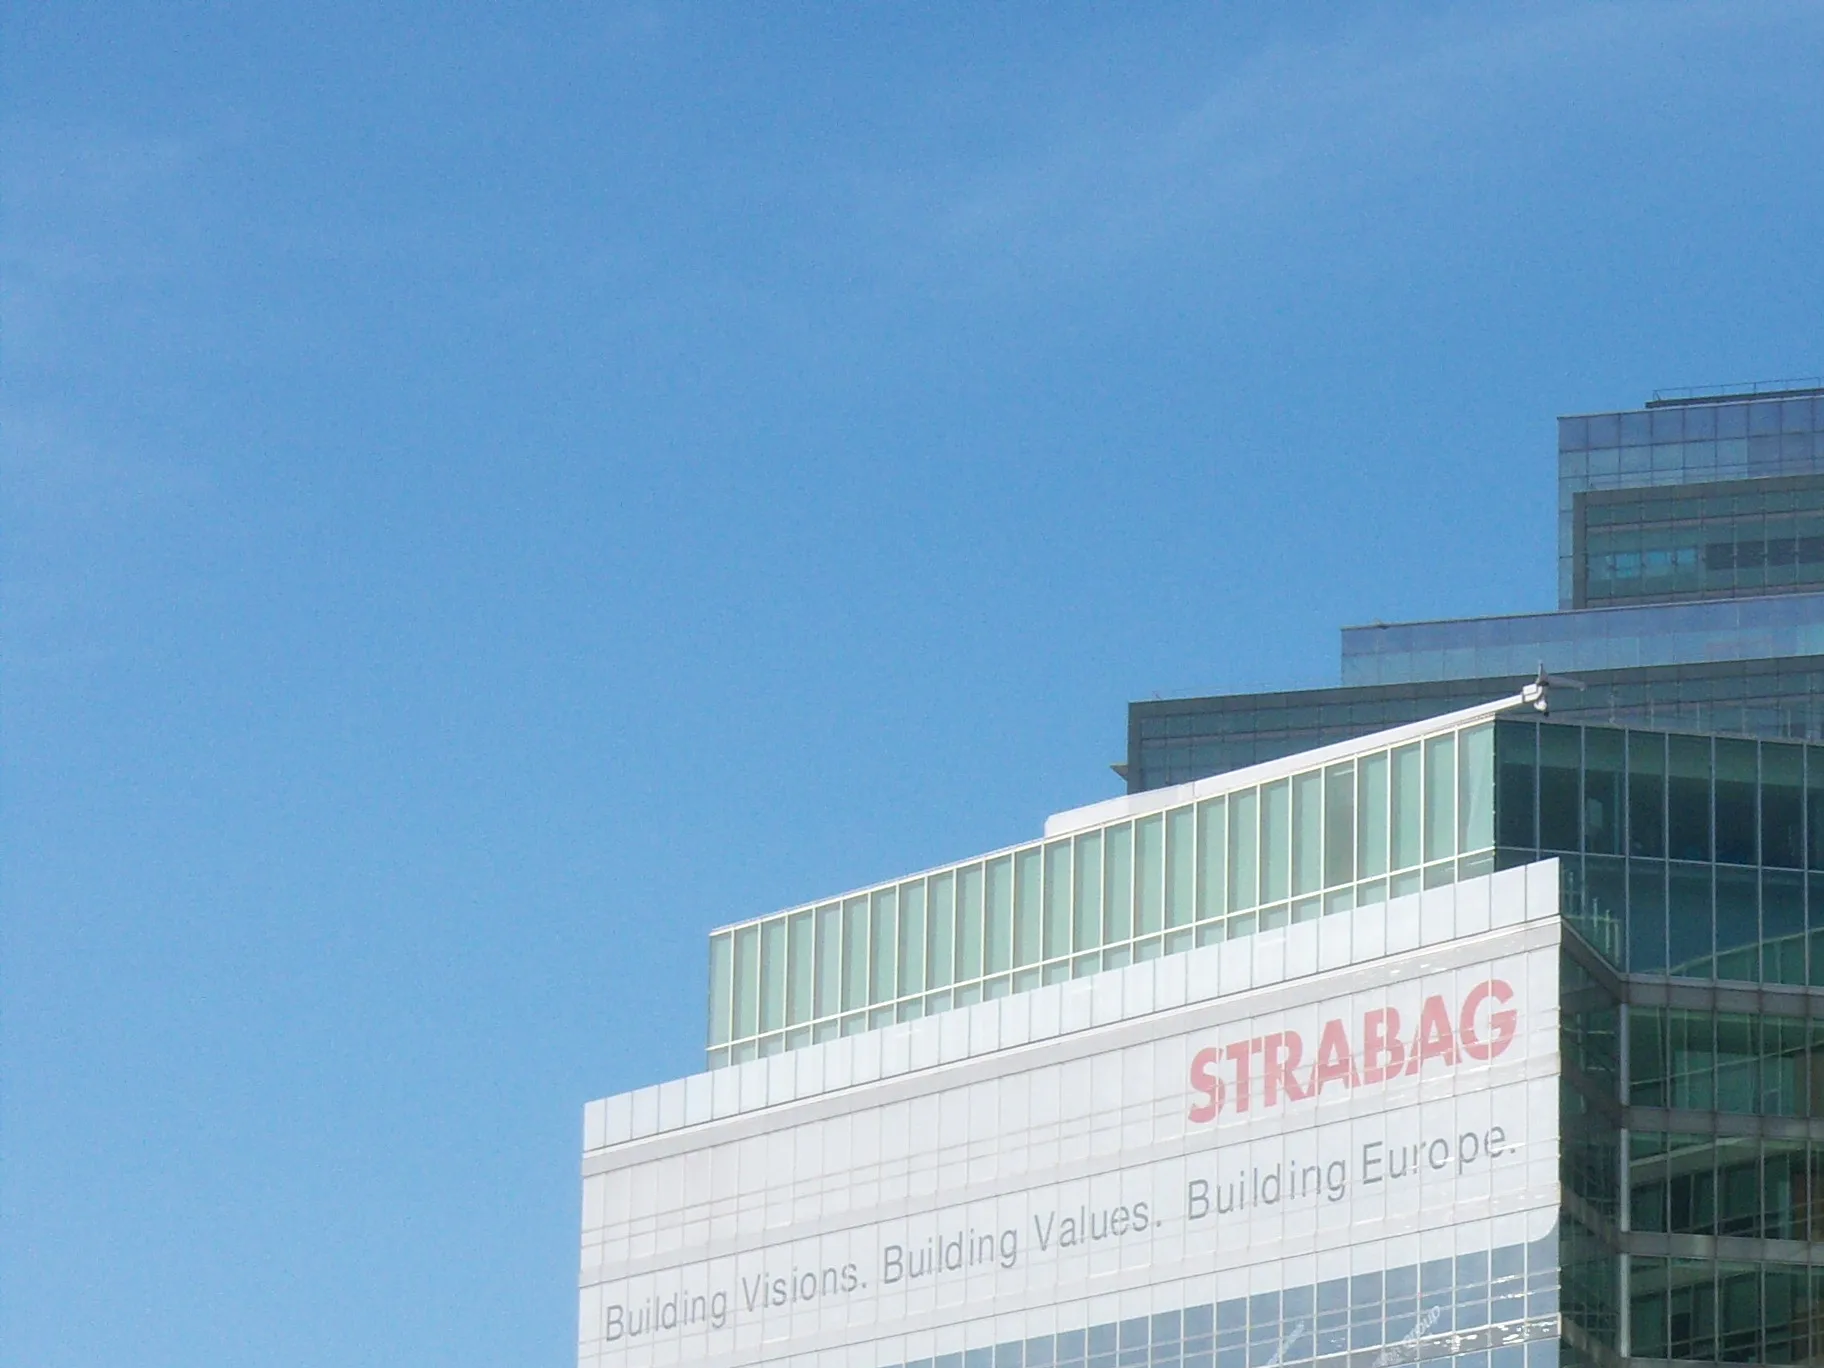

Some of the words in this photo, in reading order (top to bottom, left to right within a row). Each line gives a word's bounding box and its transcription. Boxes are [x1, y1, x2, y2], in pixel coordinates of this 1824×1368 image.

[1187, 979, 1518, 1124] STRABAG
[605, 1289, 728, 1342] Building
[741, 1261, 868, 1313] Visions.
[883, 1227, 1018, 1285] Building
[1033, 1200, 1162, 1252] Values.
[1188, 1158, 1347, 1221] Building
[1362, 1125, 1517, 1186] Europe.
